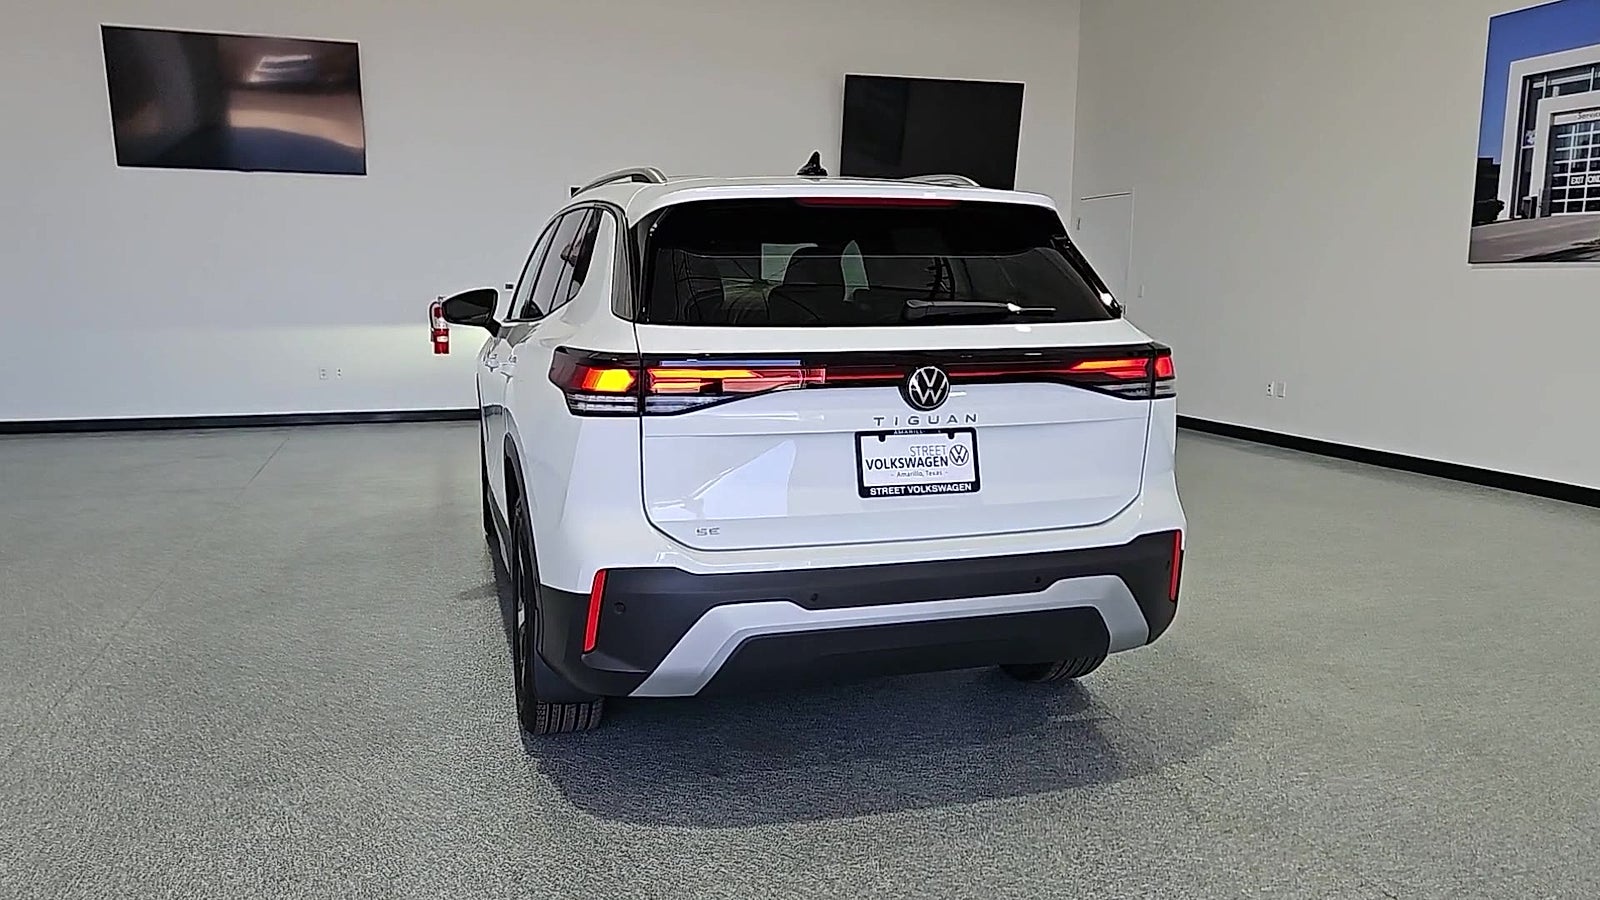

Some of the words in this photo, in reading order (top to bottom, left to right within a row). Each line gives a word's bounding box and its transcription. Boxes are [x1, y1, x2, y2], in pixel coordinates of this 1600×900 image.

[873, 413, 977, 426] TIGUAN
[910, 445, 947, 457] STREET
[865, 456, 949, 470] VOLKSWAGEN
[870, 486, 906, 496] STREET
[907, 483, 972, 494] VOLKSWAGEN
[696, 527, 720, 537] SE
